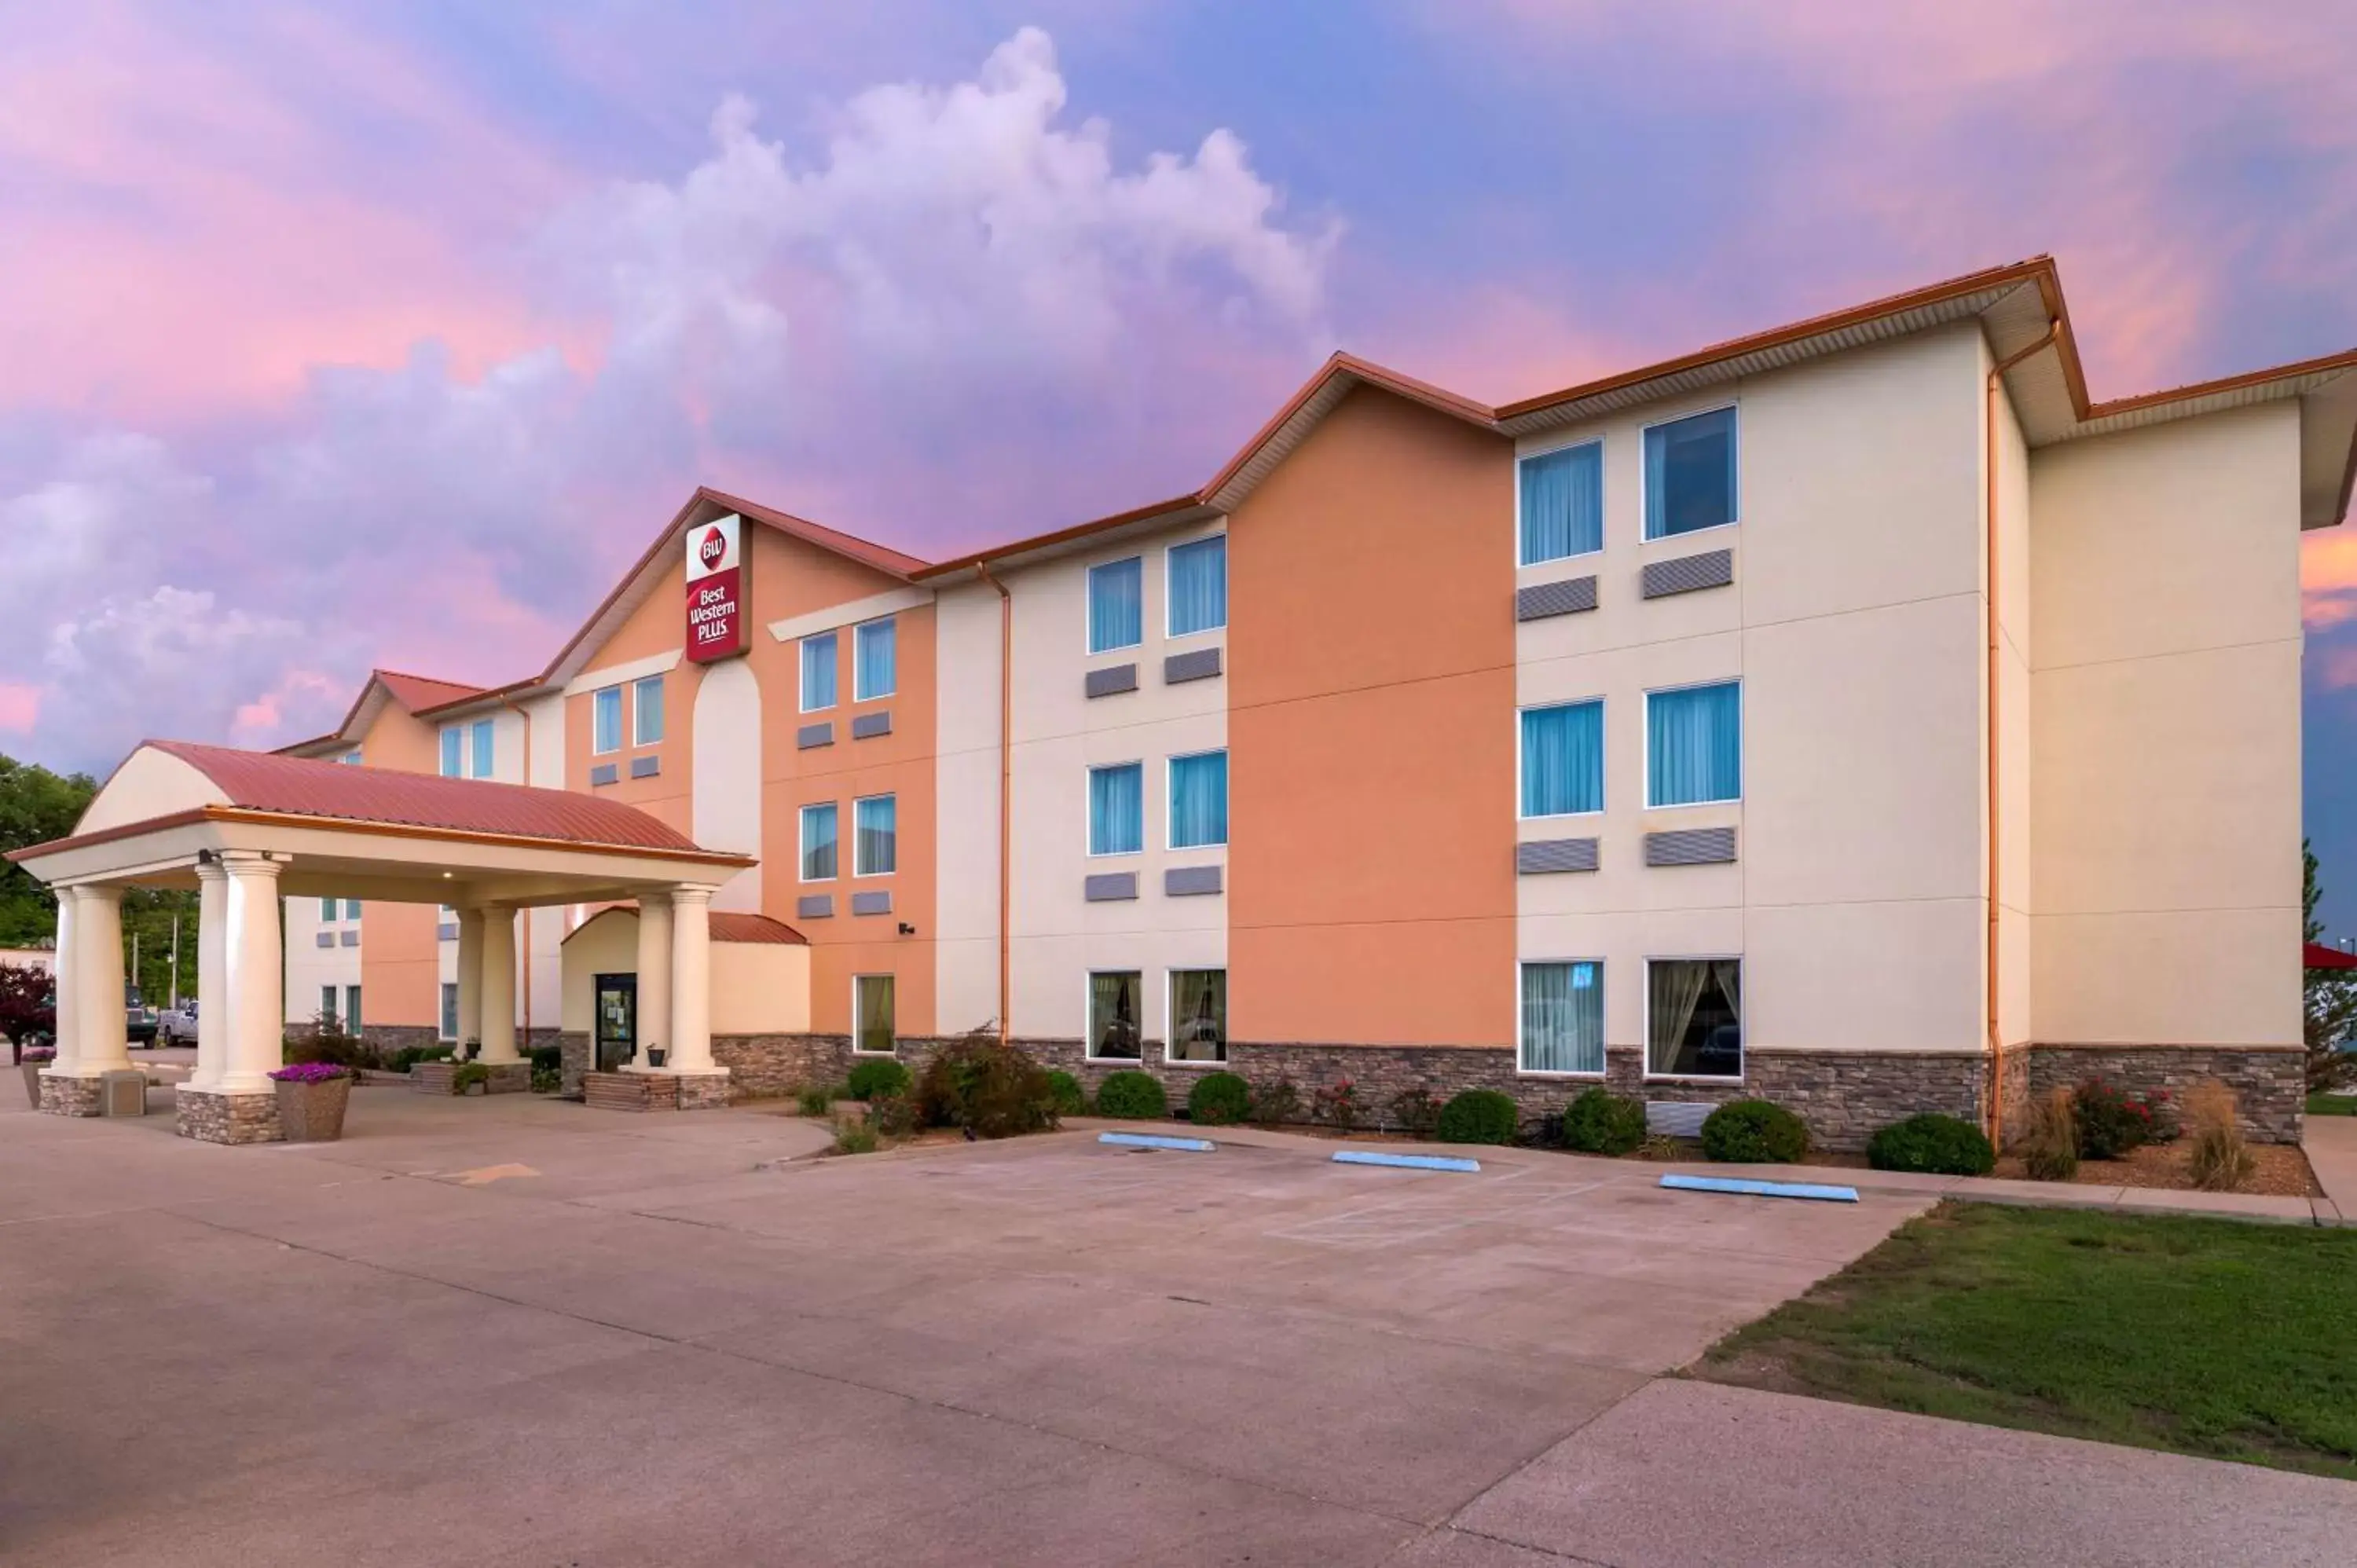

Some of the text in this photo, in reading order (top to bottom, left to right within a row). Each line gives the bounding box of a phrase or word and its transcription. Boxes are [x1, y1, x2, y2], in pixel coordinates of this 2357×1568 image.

[703, 538, 723, 559] BW
[701, 586, 724, 606] Best
[691, 601, 735, 625] Western
[698, 619, 727, 640] PLUS
